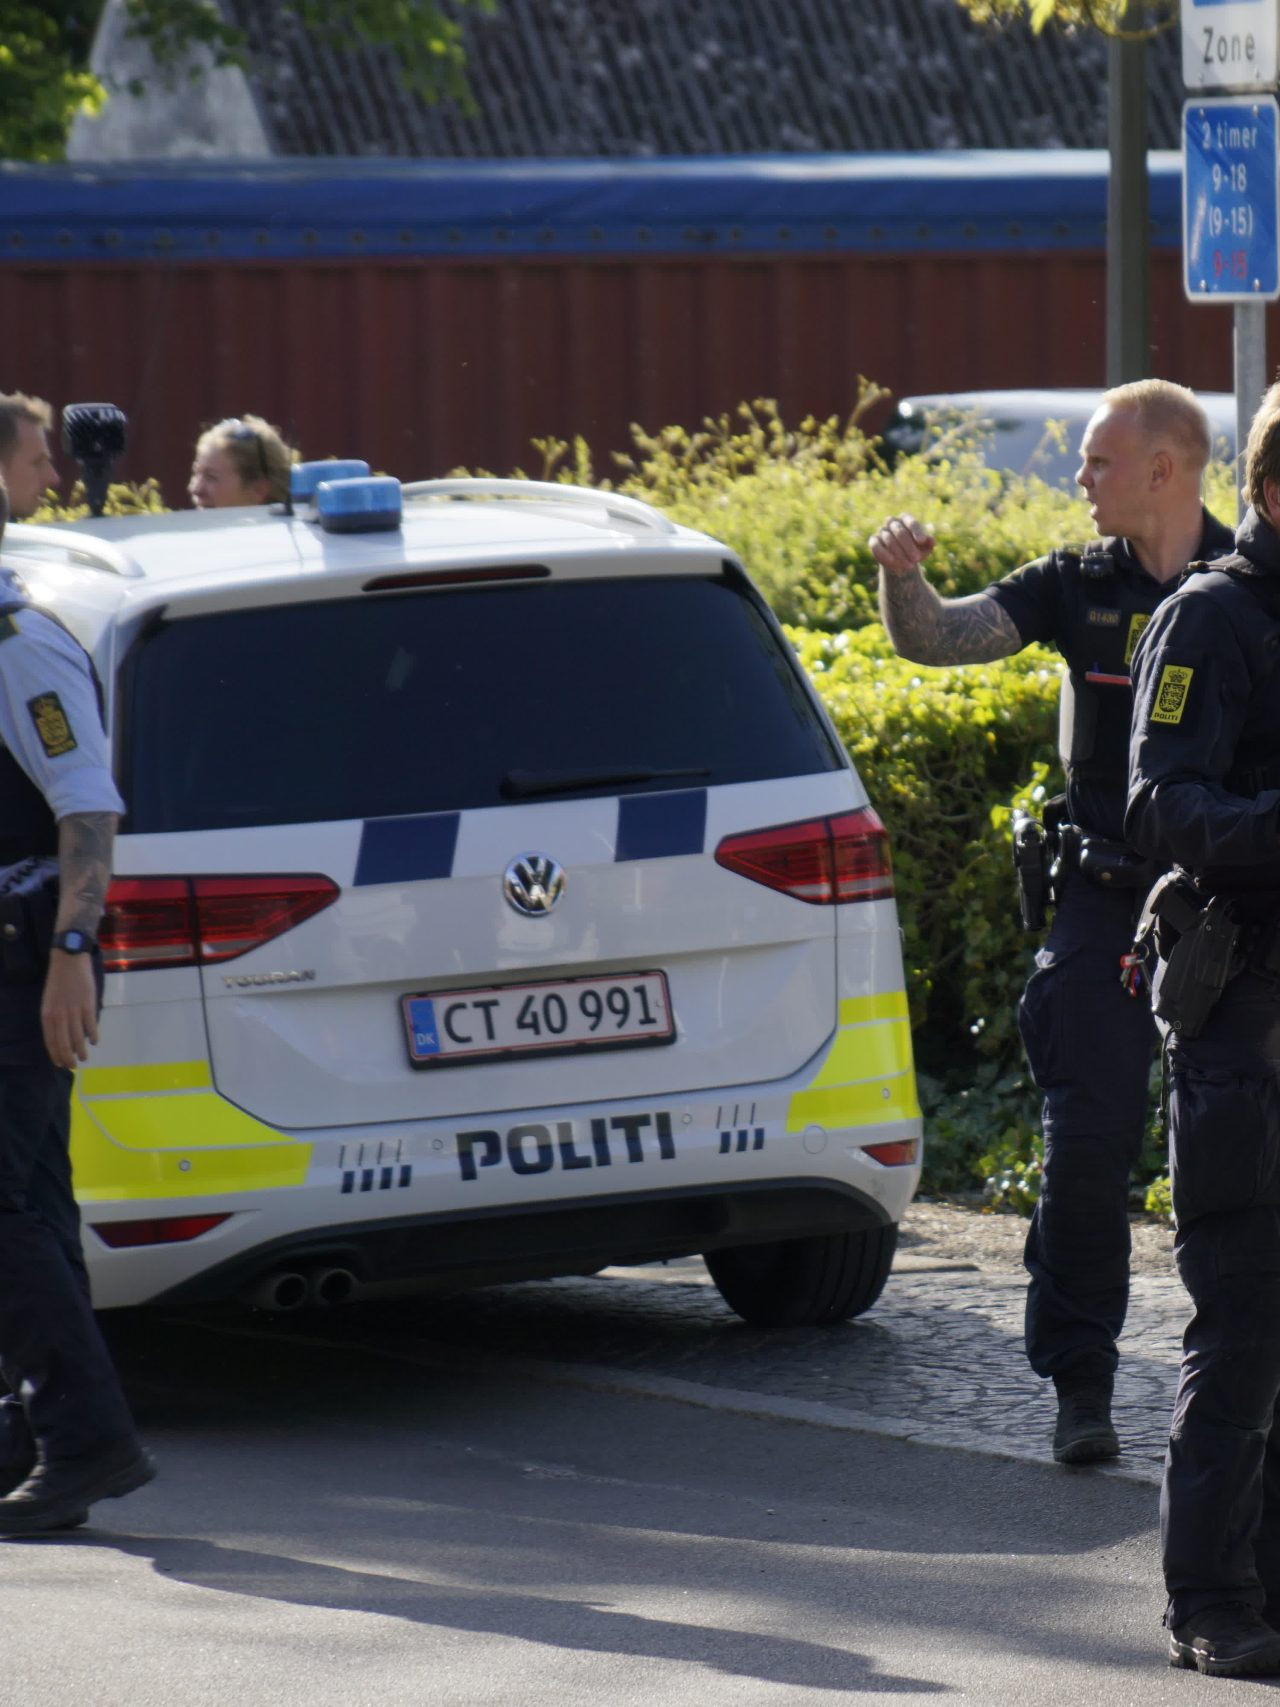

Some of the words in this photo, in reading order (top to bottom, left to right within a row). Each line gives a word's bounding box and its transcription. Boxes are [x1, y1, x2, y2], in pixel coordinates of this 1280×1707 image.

[1203, 26, 1256, 64] Zone
[1202, 122, 1212, 149] 2
[1216, 122, 1259, 149] timer
[1211, 163, 1247, 193] 9-18
[1208, 204, 1254, 238] (9-15)
[443, 999, 500, 1044] CT
[515, 992, 568, 1036] 40
[578, 984, 658, 1032] 991
[416, 1032, 437, 1046] DK
[456, 1111, 676, 1181] POLITI
